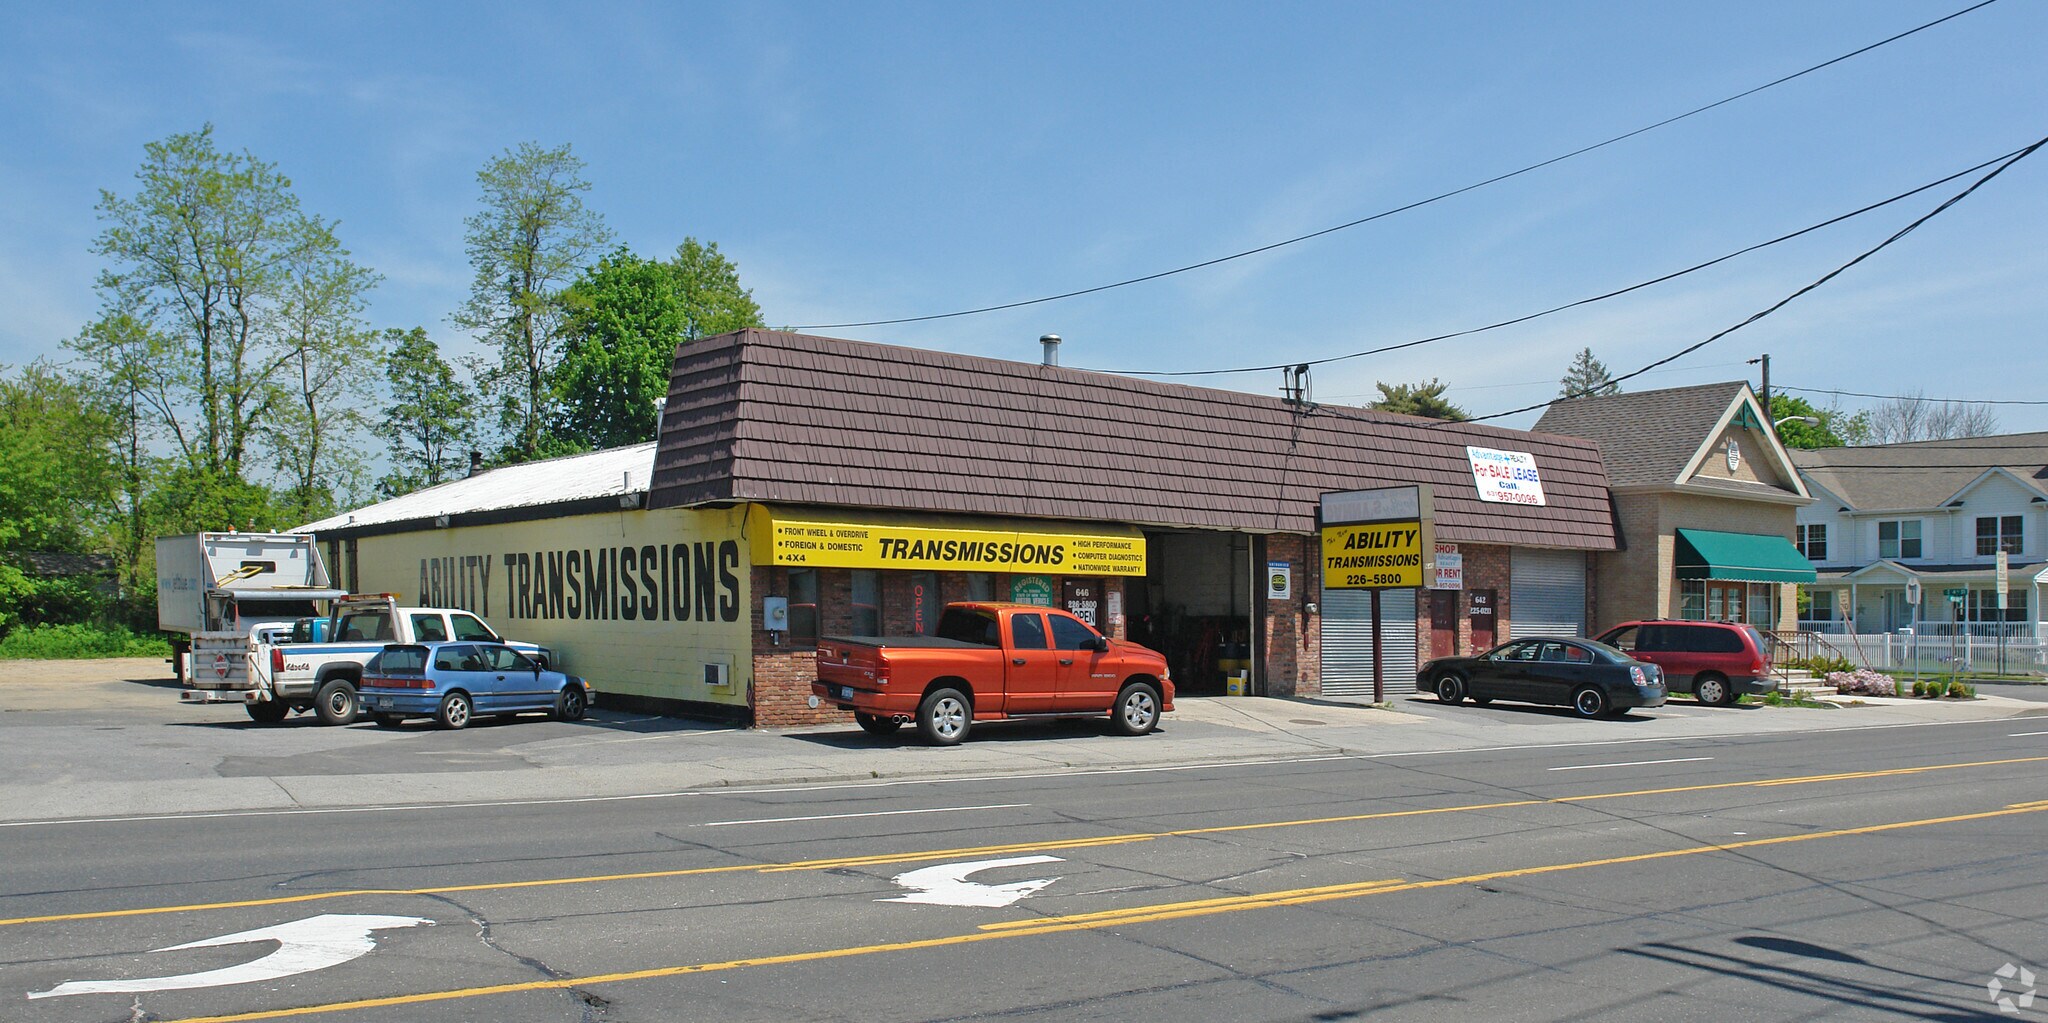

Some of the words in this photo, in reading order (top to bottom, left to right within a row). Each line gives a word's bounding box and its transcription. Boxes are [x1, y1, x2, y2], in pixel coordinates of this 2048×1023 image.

[1474, 463, 1487, 477] For
[1497, 491, 1538, 504] 957-0096
[785, 528, 805, 536] FRONT
[807, 529, 828, 537] WHEEL
[836, 530, 869, 539] OVERDRIVE
[1344, 529, 1417, 550] ABILITY
[785, 541, 817, 550] FOREIGN
[819, 542, 825, 550] &
[827, 543, 863, 552] DOMESTIC
[1092, 541, 1132, 550] PERFORMANCE
[879, 538, 1065, 565] TRANSMISSIONS
[785, 554, 806, 562] 4X4
[1108, 554, 1143, 562] DIAGNOSTICS
[1327, 553, 1419, 569] TRANSMISSIONS
[1078, 564, 1110, 572] NATIONWIDE
[1443, 568, 1461, 578] RENT
[419, 554, 492, 619] ABILITY
[504, 540, 740, 623] TRANSMISSIONS
[1014, 576, 1050, 593] REGISTERED
[1346, 573, 1402, 585] 226-5800
[1075, 588, 1089, 597] 646
[1067, 600, 1098, 609] 226-5800
